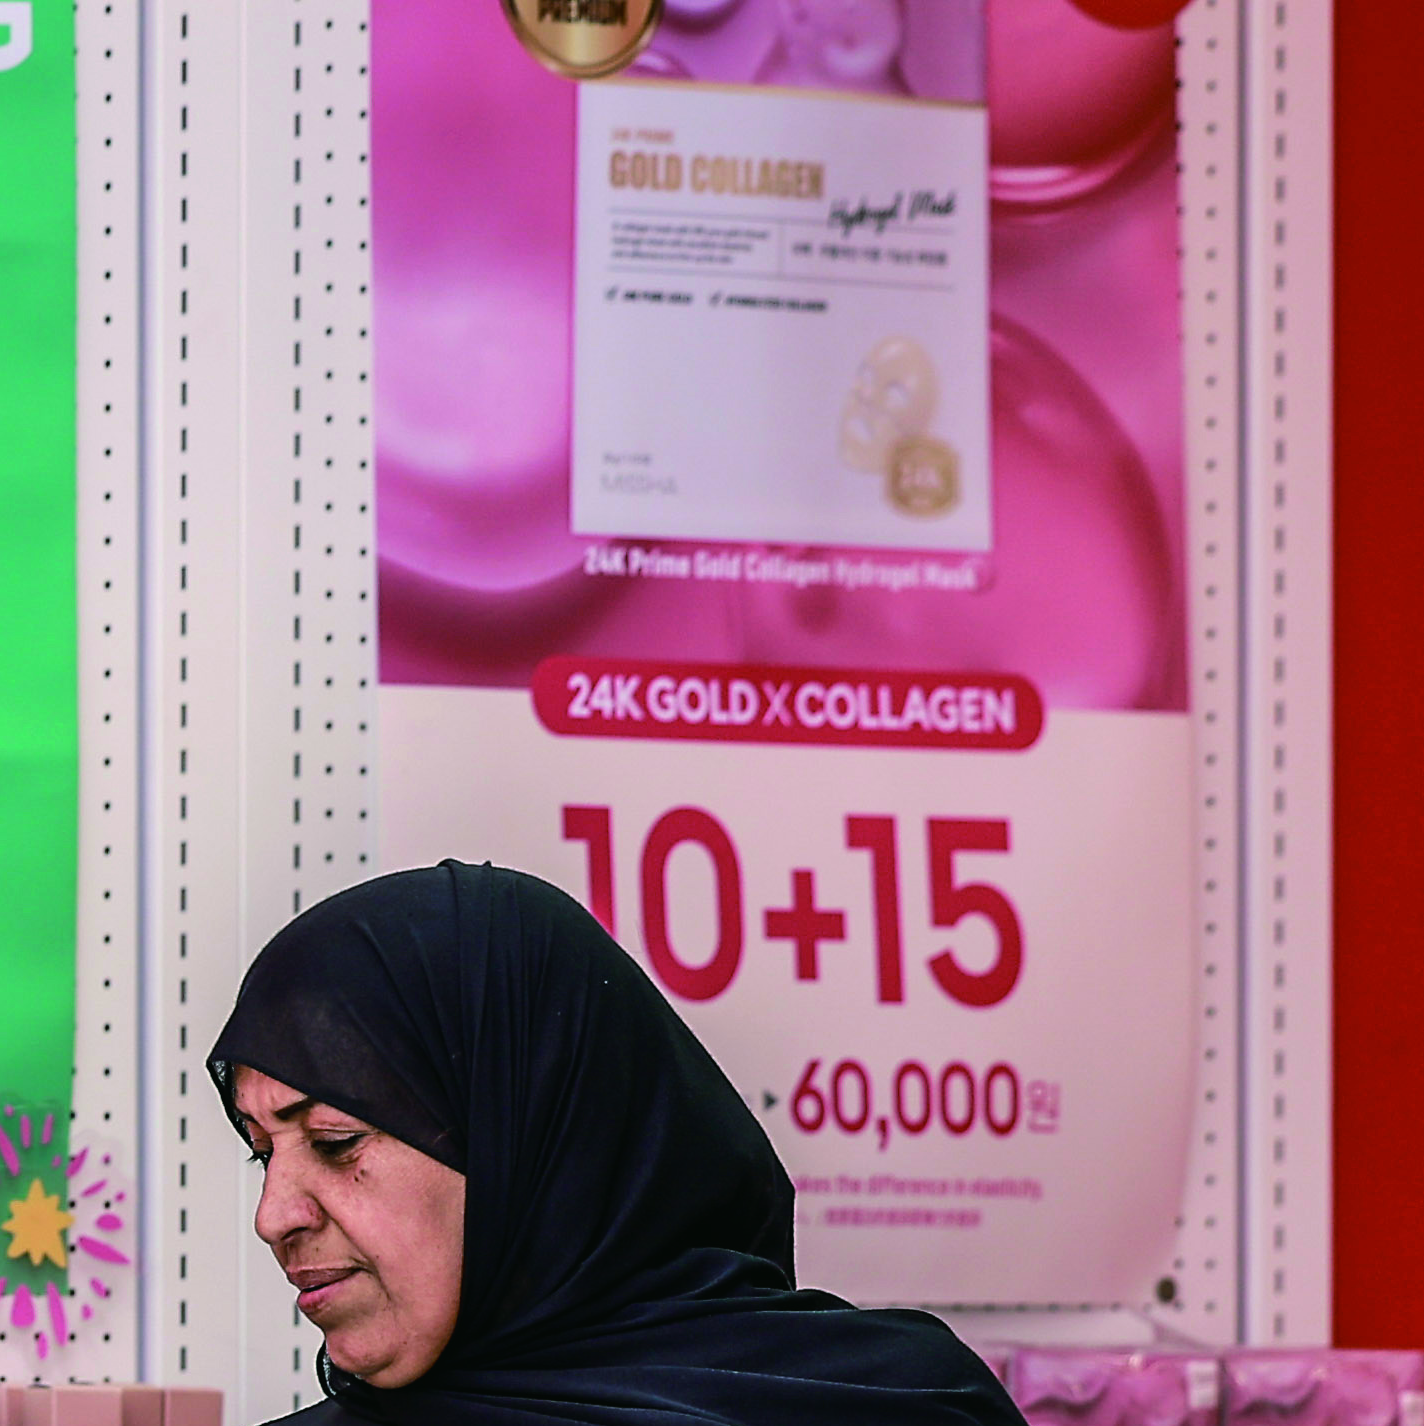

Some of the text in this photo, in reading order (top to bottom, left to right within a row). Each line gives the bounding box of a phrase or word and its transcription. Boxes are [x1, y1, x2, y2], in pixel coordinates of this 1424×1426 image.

[609, 150, 825, 201] GOLD COLLAGEN
[628, 548, 691, 578] Prime
[694, 550, 743, 581] Gold
[745, 553, 829, 585] Collagen
[567, 673, 644, 721] 24K
[646, 674, 759, 726] GOLD
[794, 681, 1016, 734] COLLAGEN
[561, 804, 1024, 1009] 10+15
